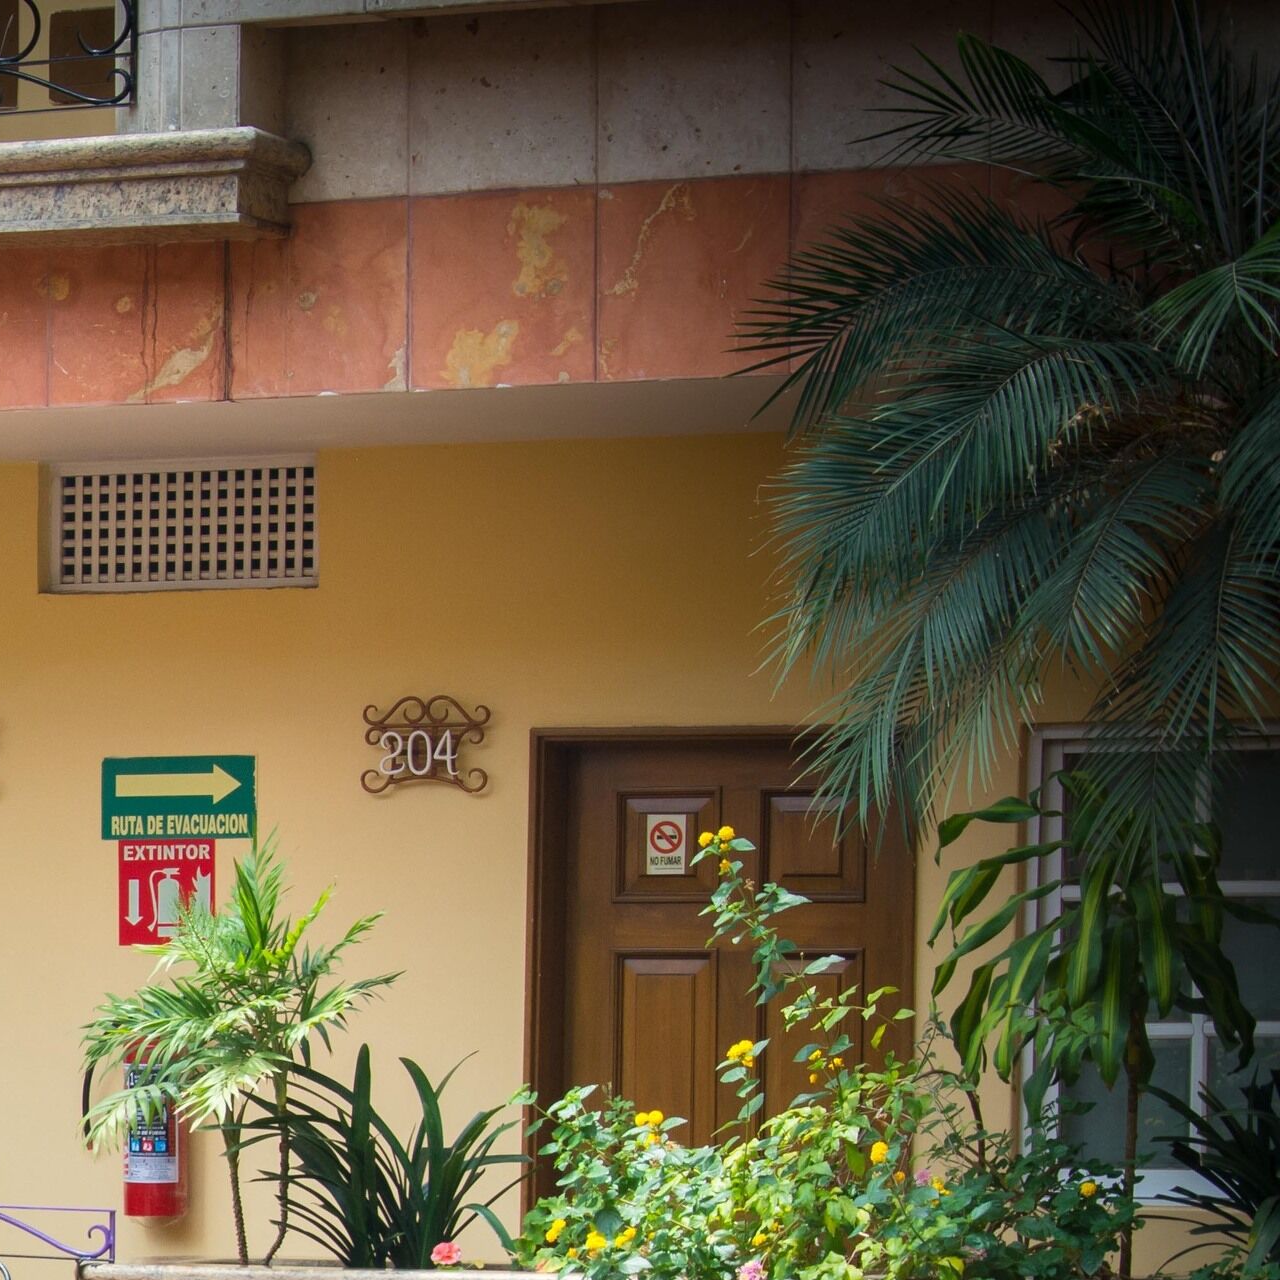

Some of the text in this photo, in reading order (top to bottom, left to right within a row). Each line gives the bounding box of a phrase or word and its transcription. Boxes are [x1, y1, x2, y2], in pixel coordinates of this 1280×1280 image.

[380, 729, 460, 776] 204
[111, 813, 248, 836] RUTA DE EVACUACION
[123, 844, 211, 861] EXTINTOR
[650, 856, 682, 866] NO FUMAR
